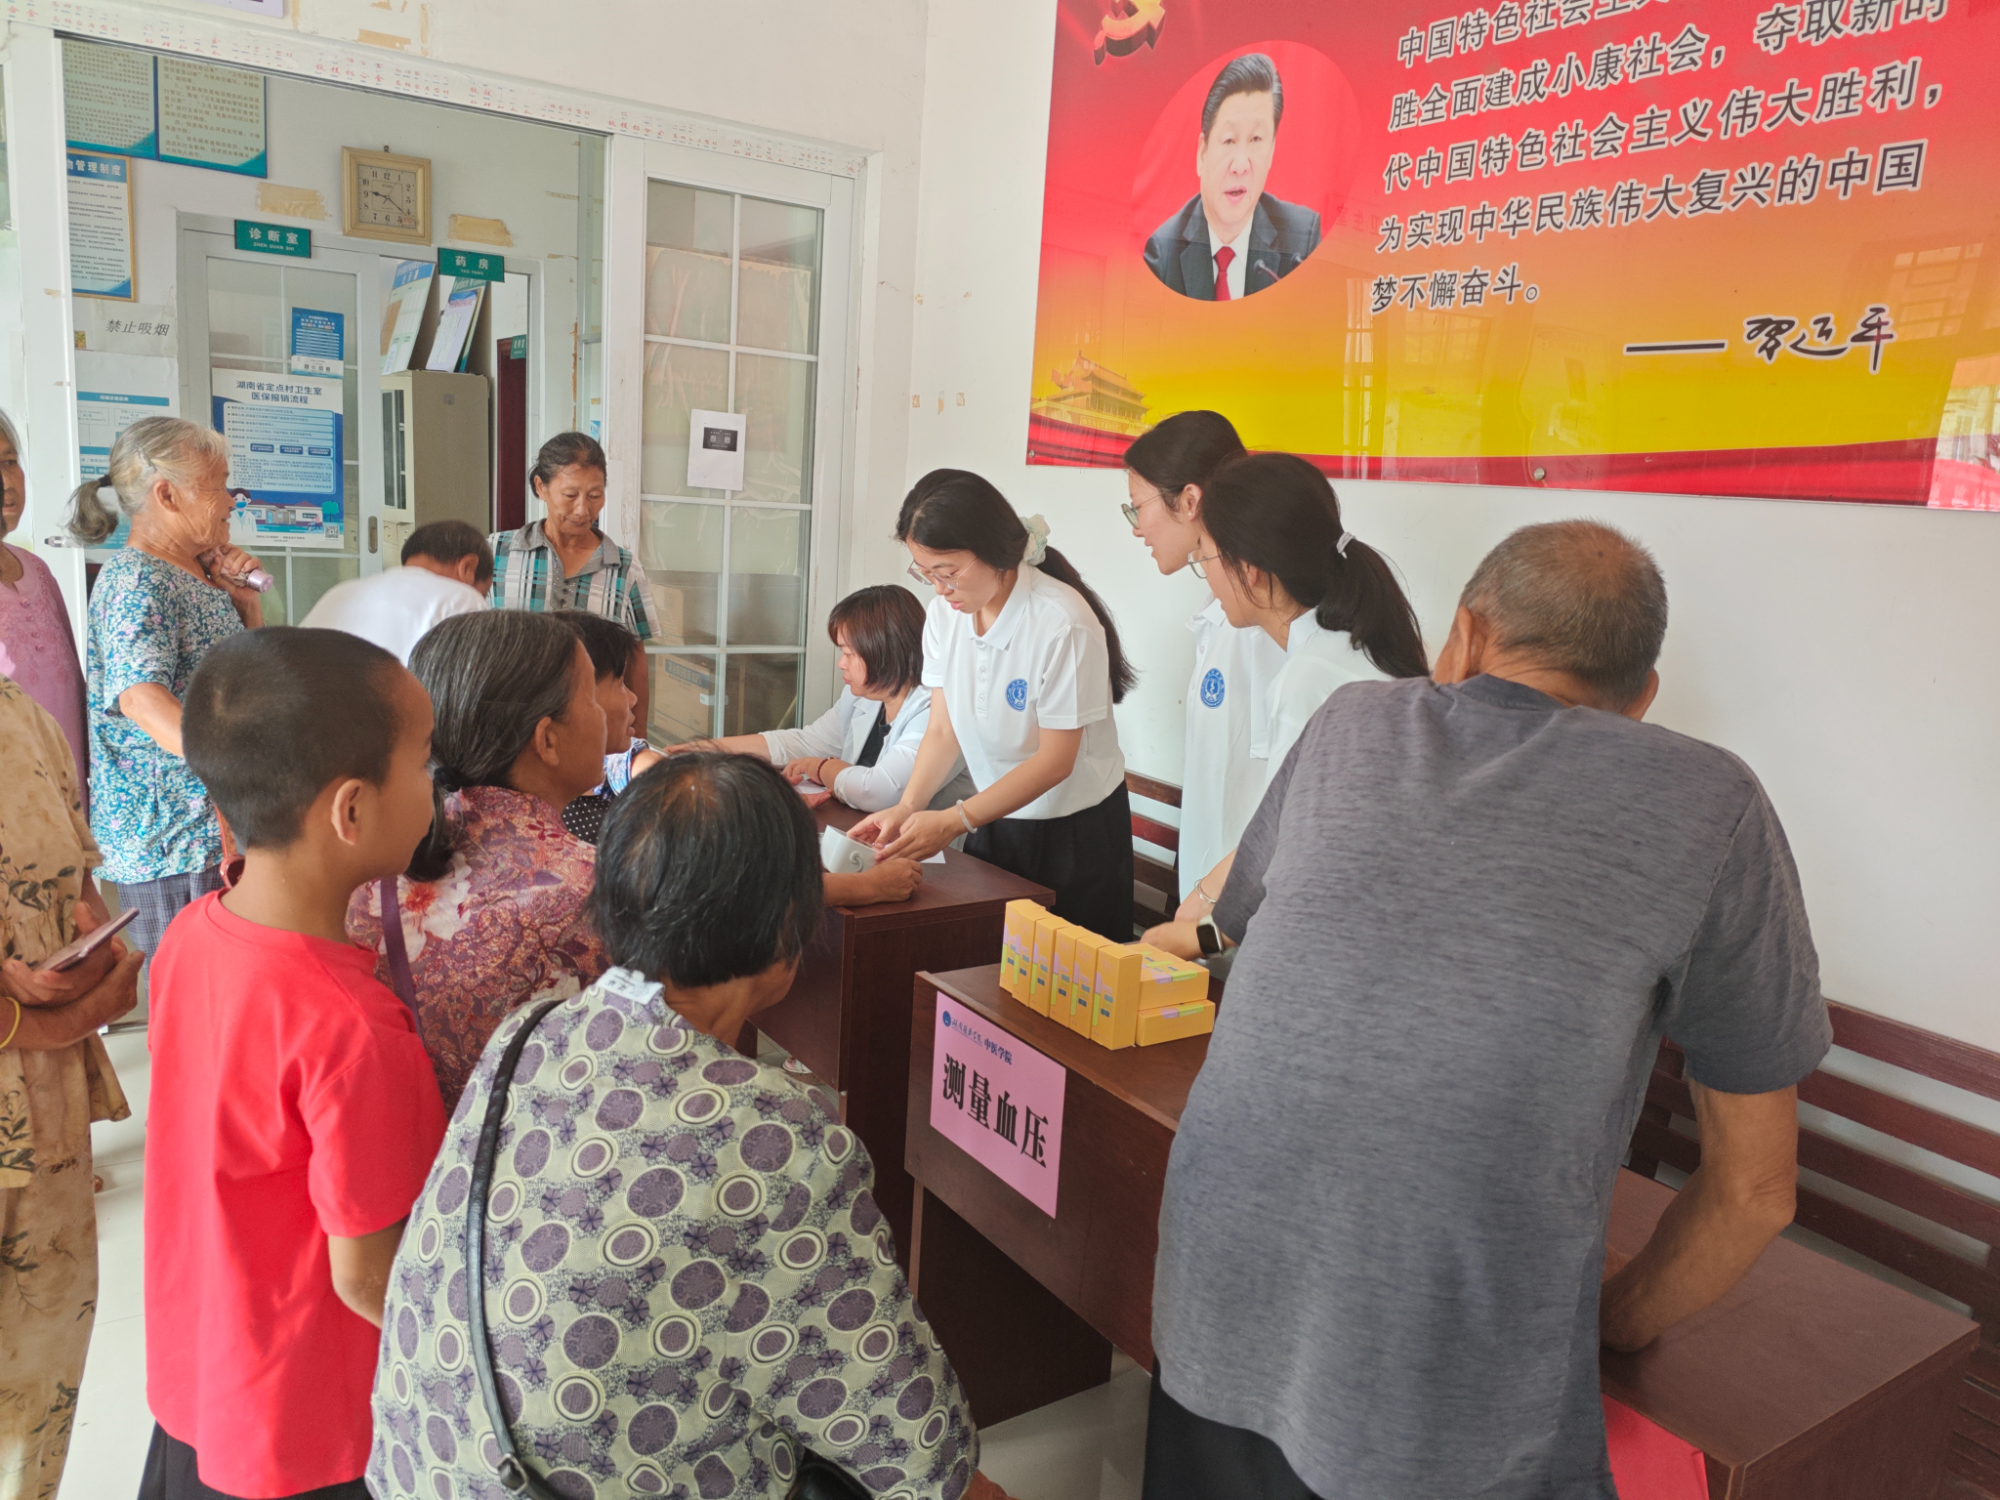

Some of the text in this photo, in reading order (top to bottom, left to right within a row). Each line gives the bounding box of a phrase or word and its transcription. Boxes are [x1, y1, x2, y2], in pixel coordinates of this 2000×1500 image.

[1398, 0, 1656, 66] 中国特色社会主
[1384, 59, 1939, 192] 代中国特色社会主义伟大胜利，
[1377, 142, 1925, 252] 为实现中华民族伟大复兴的中国
[248, 227, 299, 245] 诊断室
[455, 255, 489, 270] 药房
[1371, 264, 1539, 312] 梦不懈奋斗。
[104, 318, 170, 338] 禁止吸烟
[236, 380, 323, 396] 湖南省定点村卫生室
[251, 391, 309, 405] 医保报销流程
[942, 1052, 1049, 1169] 测量血压
